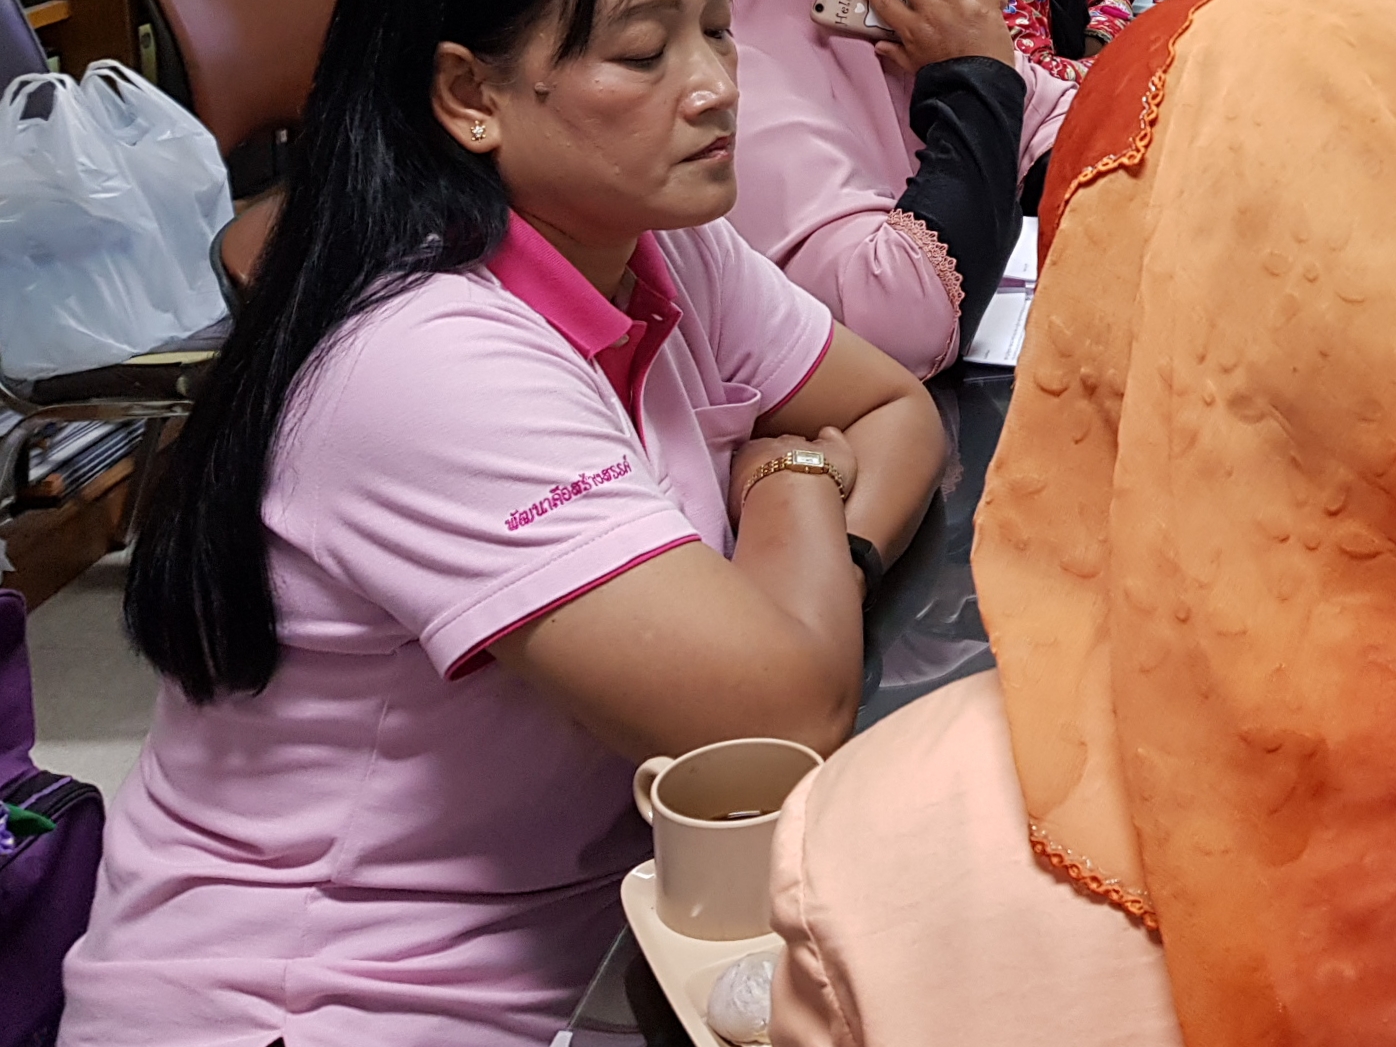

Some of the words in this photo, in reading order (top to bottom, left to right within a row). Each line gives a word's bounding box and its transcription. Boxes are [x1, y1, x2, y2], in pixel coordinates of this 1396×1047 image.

[504, 455, 633, 532] พัฒนาคือสร้างสรรค์
